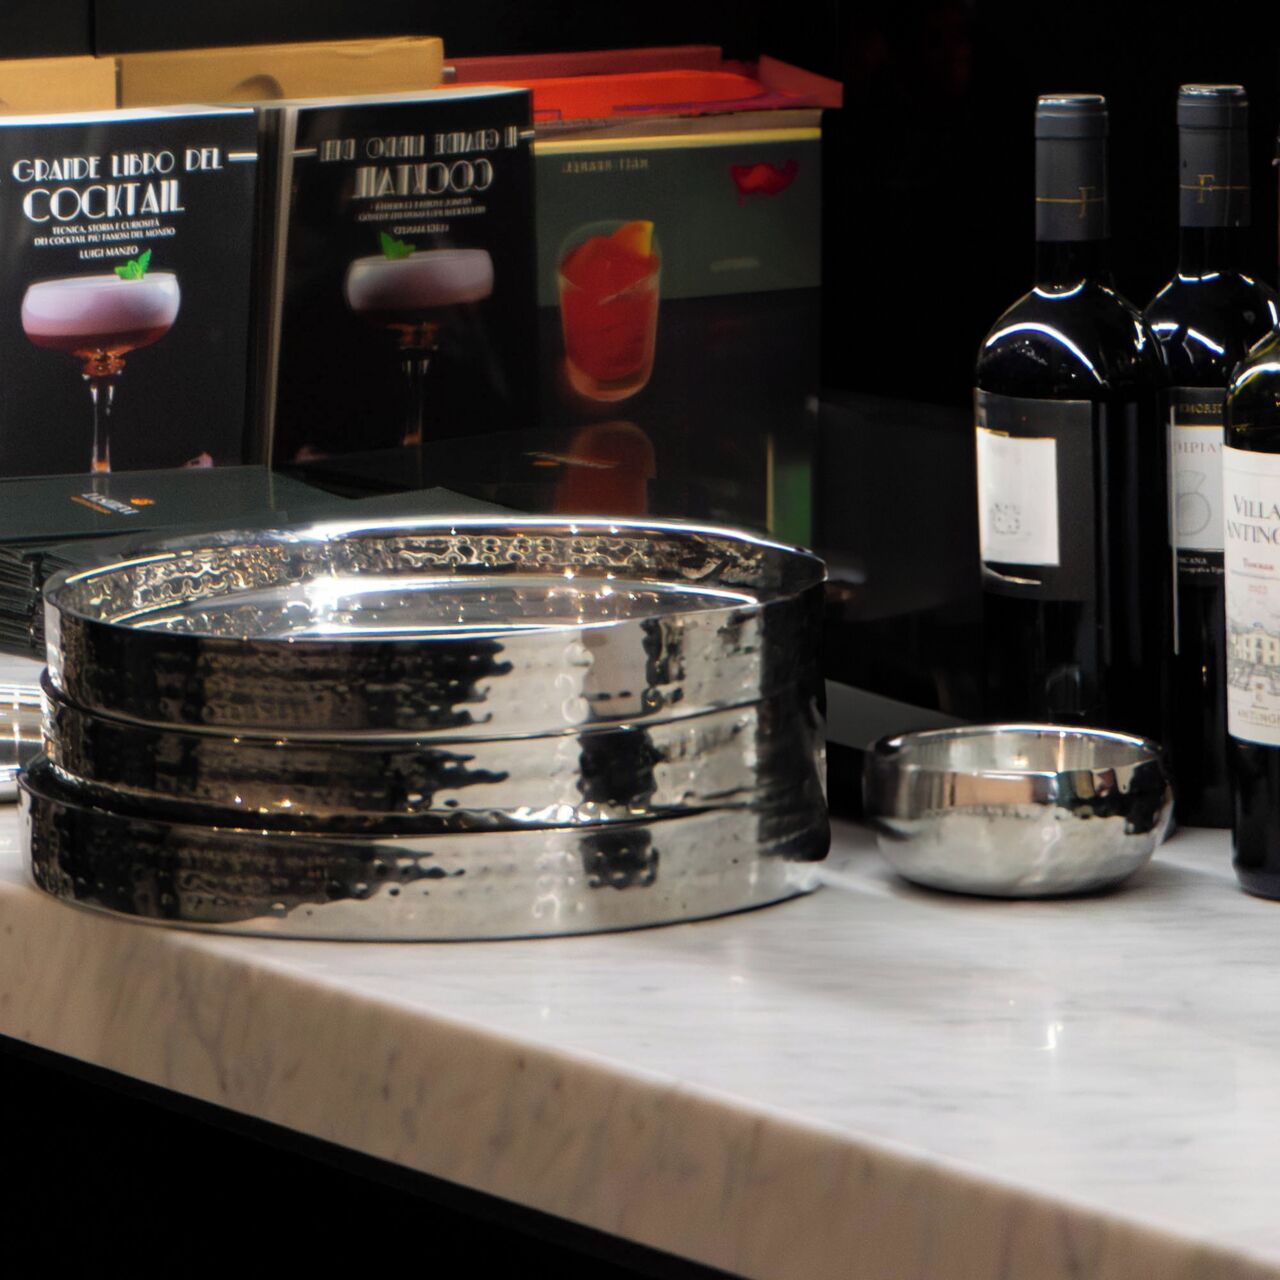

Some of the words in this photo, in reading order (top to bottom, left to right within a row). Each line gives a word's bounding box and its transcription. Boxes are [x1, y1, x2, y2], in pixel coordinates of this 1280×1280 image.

[11, 155, 102, 183] GRANDE
[111, 150, 176, 178] LIBRO
[184, 147, 224, 172] DEL
[23, 178, 186, 223] COCKTAIL
[48, 234, 86, 246] COCKTAIL
[101, 231, 131, 242] FAMOSI
[145, 226, 177, 238] MONDO
[78, 248, 104, 260] LUIGI
[104, 245, 140, 258] MANZO
